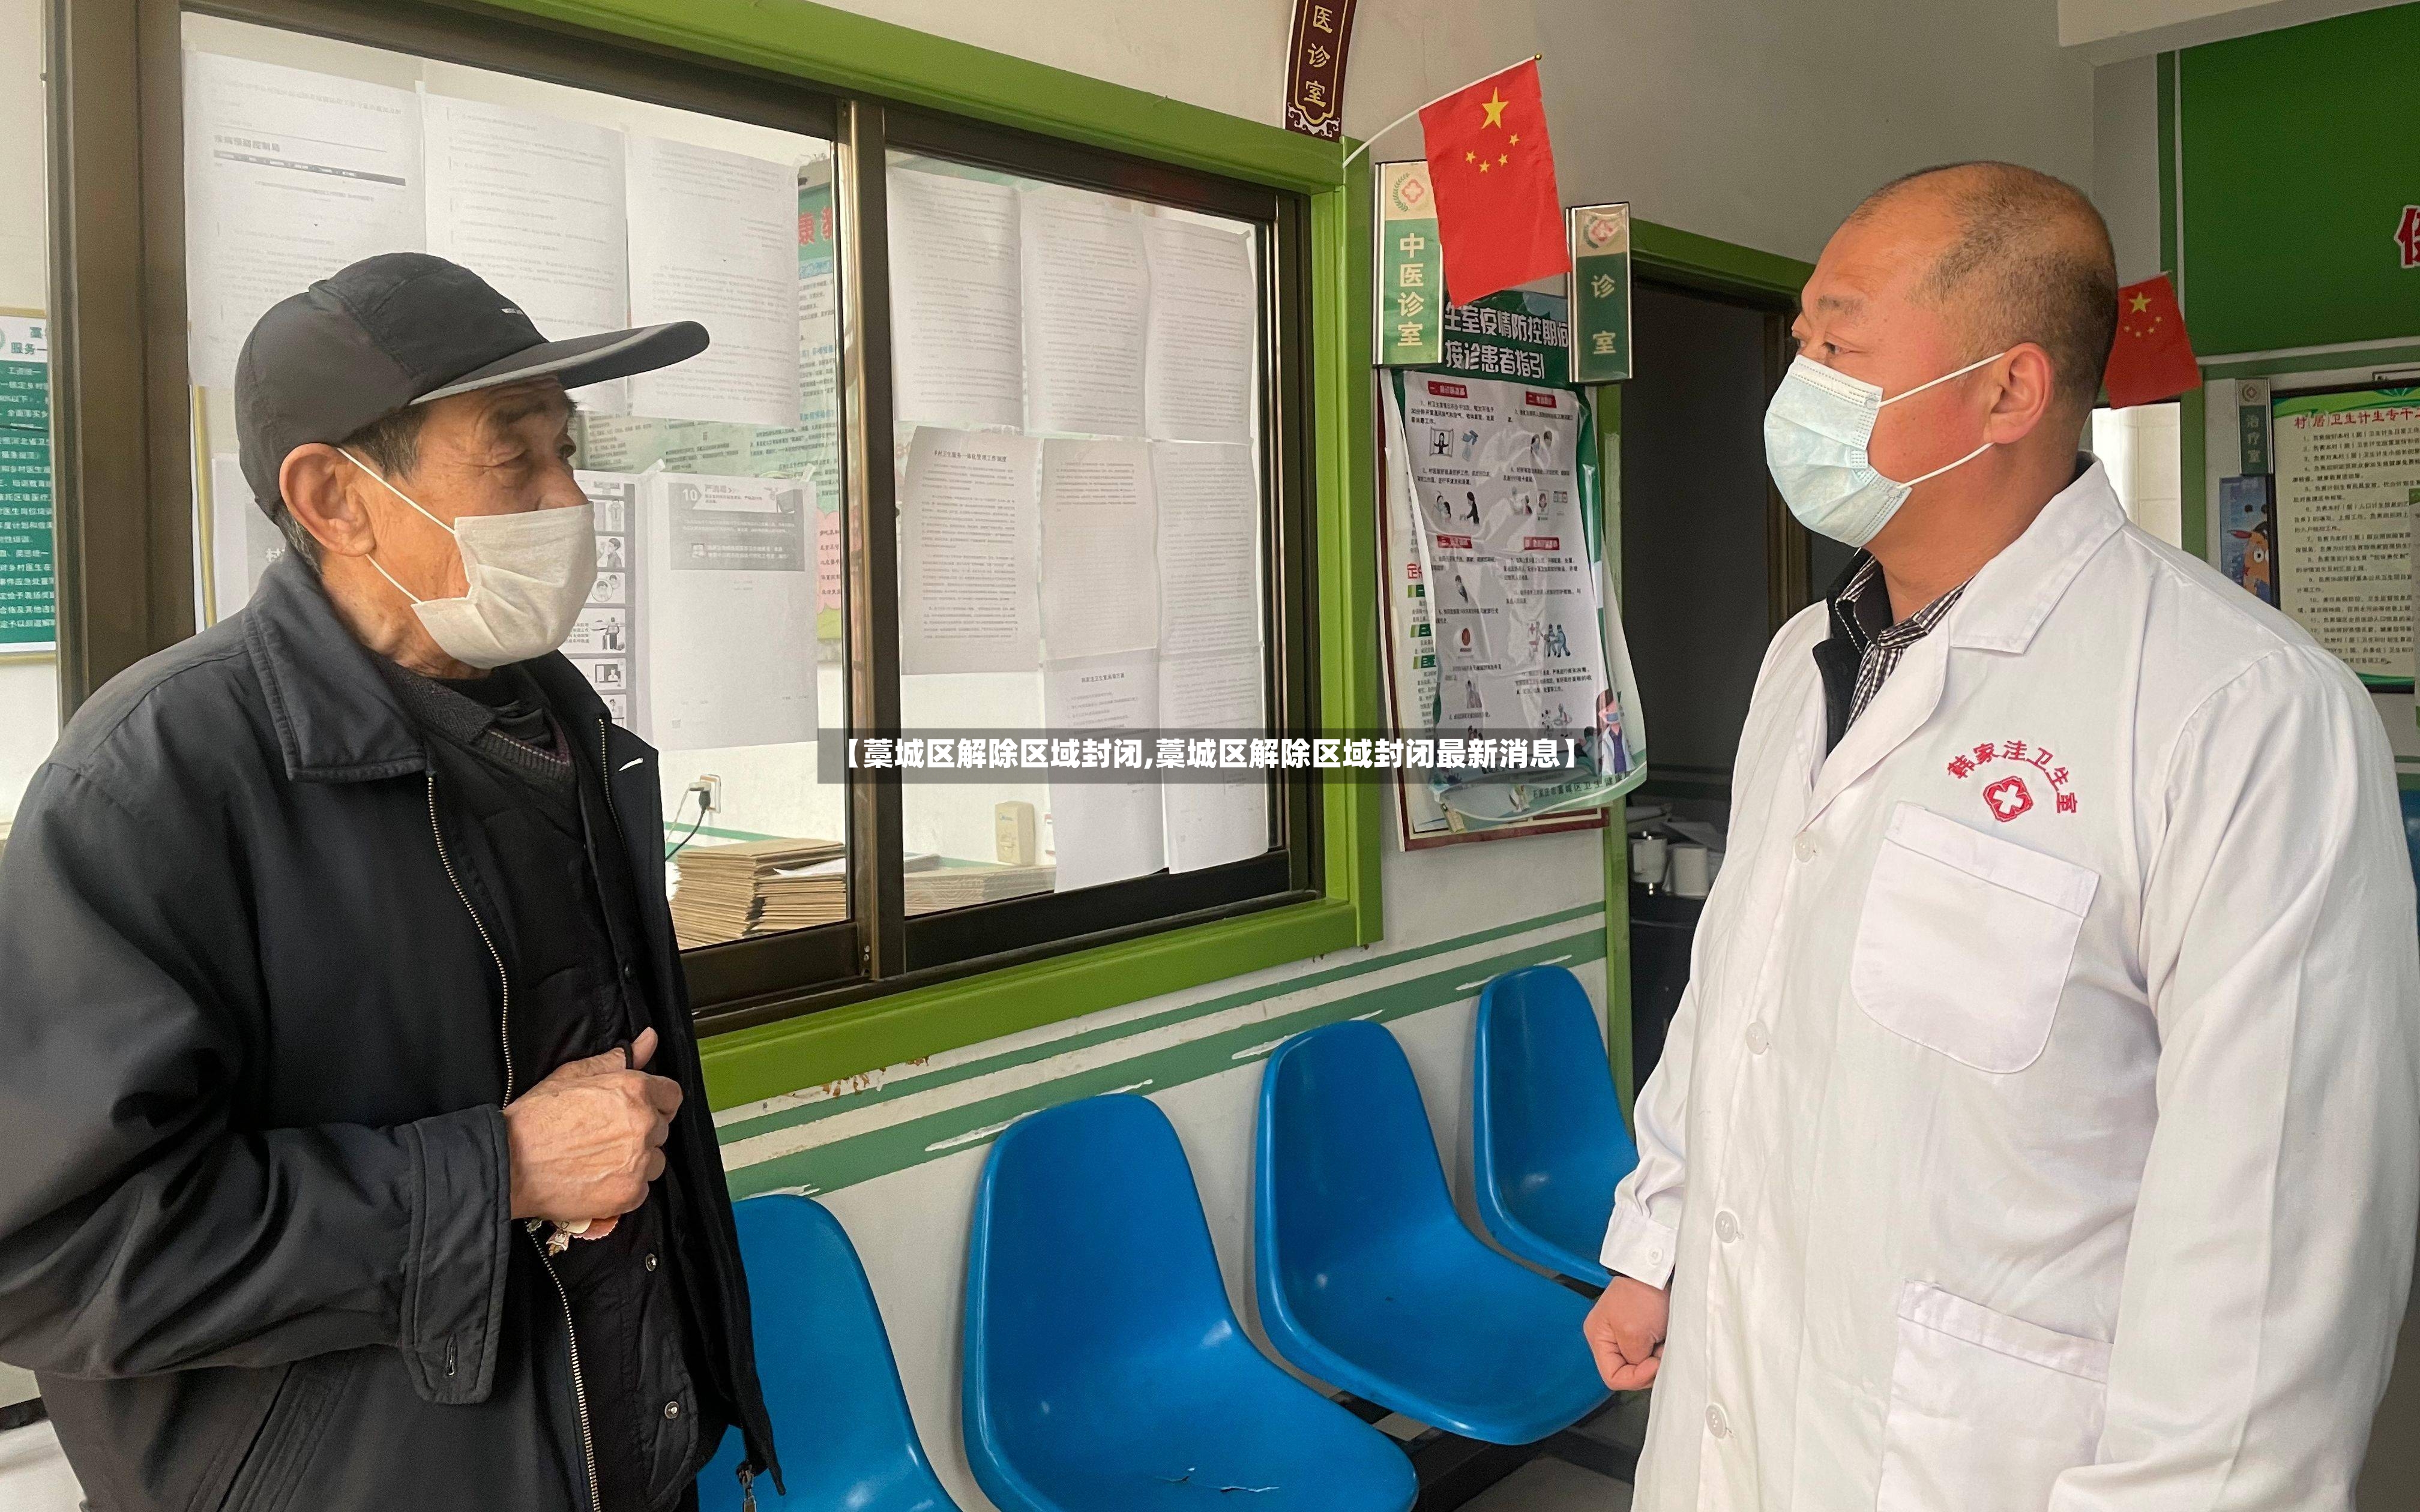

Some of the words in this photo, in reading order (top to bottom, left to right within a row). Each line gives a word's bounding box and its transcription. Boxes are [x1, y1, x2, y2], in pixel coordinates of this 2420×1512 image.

[1397, 232, 1424, 347] 中医诊室
[1445, 340, 1545, 379] 接诊患者指引
[682, 488, 698, 501] 10
[1946, 740, 2078, 814] 韩家洼卫生室
